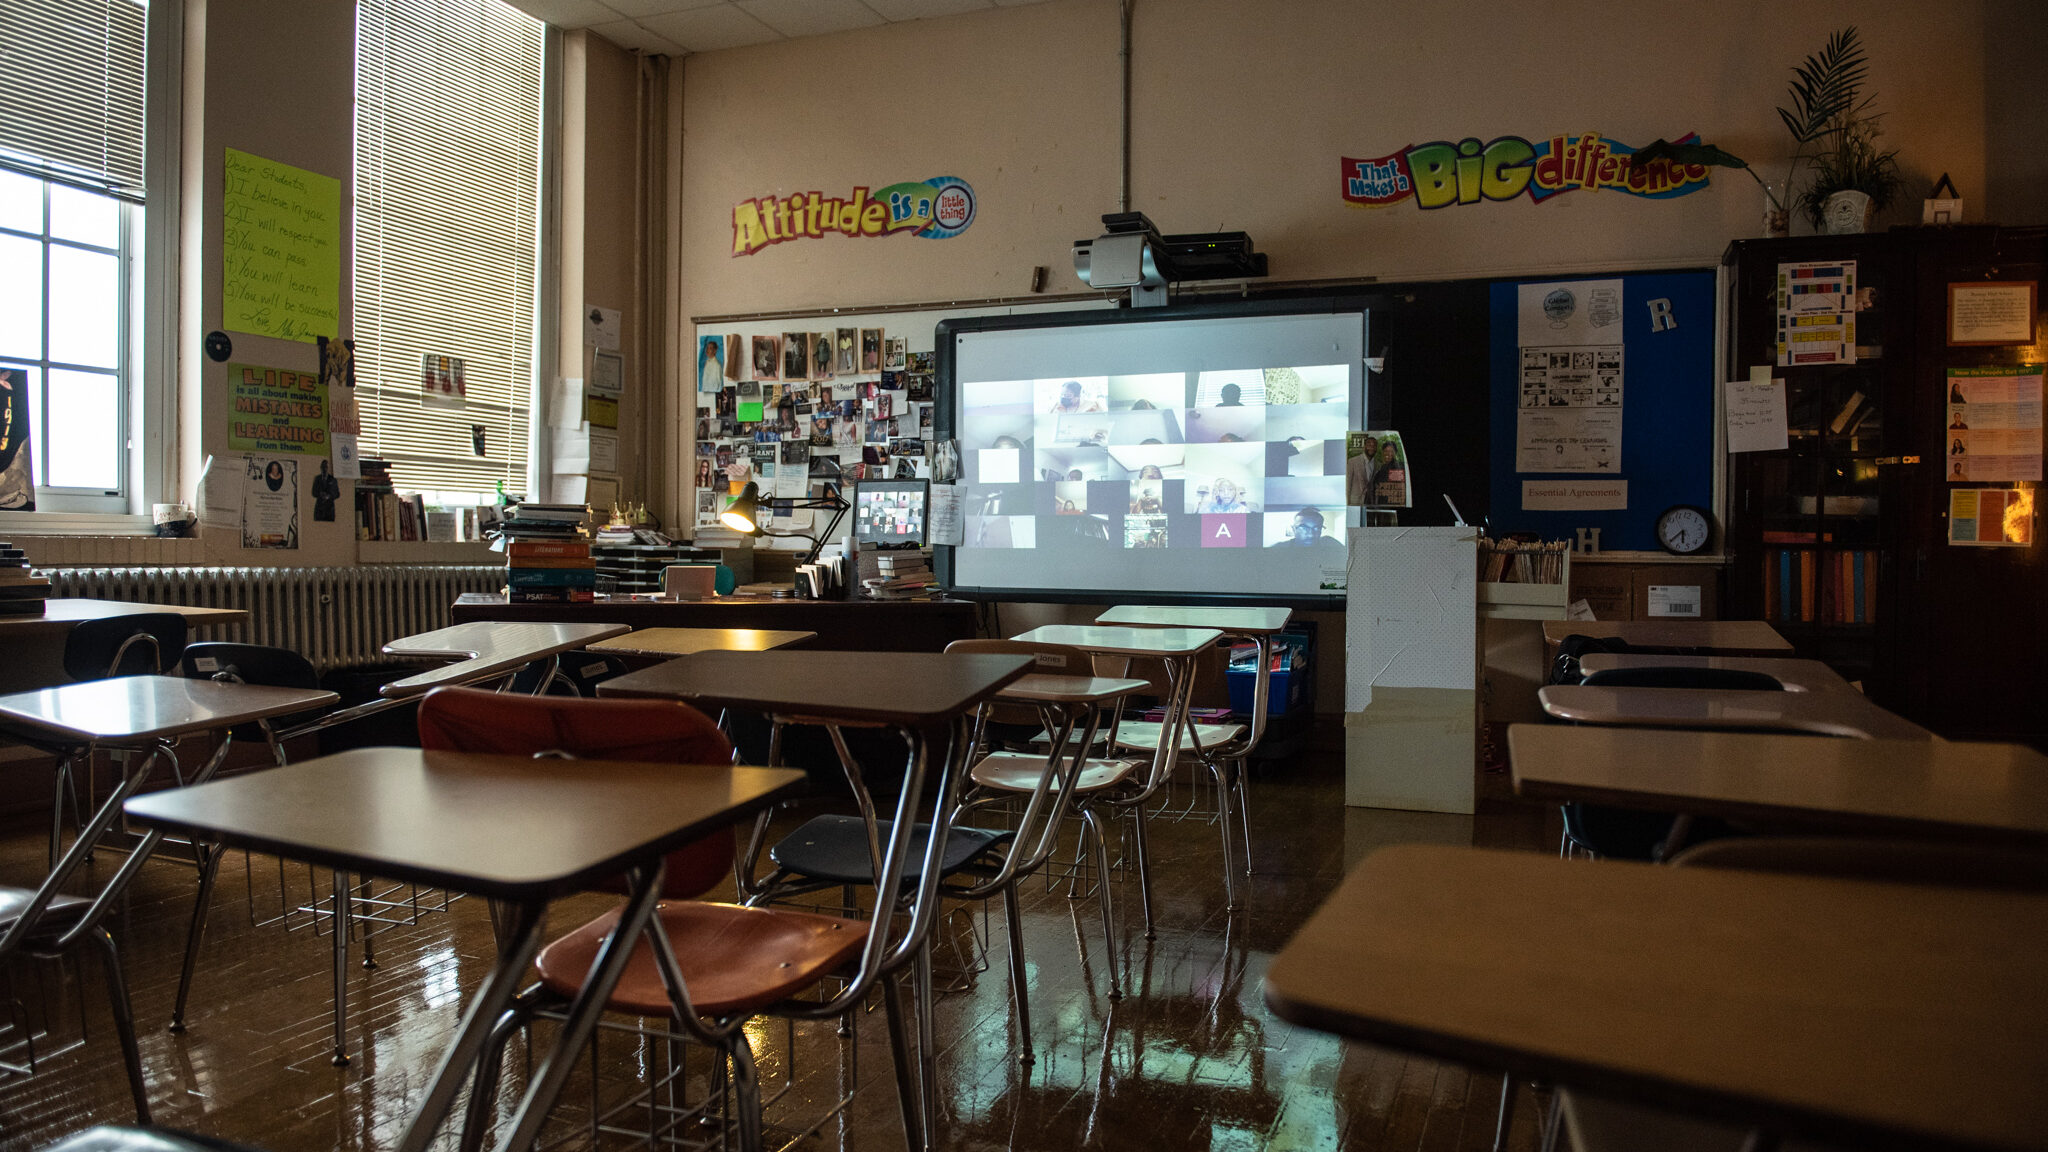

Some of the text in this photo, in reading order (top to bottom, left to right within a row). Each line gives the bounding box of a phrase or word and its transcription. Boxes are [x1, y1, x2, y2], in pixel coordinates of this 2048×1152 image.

[225, 153, 255, 174] Dear
[1357, 159, 1400, 181] That
[1534, 131, 1710, 195] difference
[1348, 175, 1409, 199] Makes a
[252, 184, 289, 210] believe
[292, 200, 302, 216] in
[941, 194, 965, 209] little
[733, 186, 931, 256] Attitude is a
[940, 205, 966, 220] thing
[258, 218, 276, 233] will
[279, 227, 314, 246] respect
[262, 245, 281, 260] can
[239, 255, 258, 279] You
[262, 271, 283, 284] will
[288, 273, 319, 297] learn
[239, 283, 256, 301] You
[260, 294, 281, 308] will
[284, 297, 296, 311] be
[1646, 297, 1678, 333] R
[242, 368, 317, 392] LIFE
[236, 385, 322, 404] is all about making
[235, 396, 322, 419] MISTAKES
[272, 416, 289, 425] and
[234, 421, 325, 444] LEARNING
[256, 440, 305, 452] from them.
[1528, 488, 1622, 499] Essential Agreements
[1684, 511, 1692, 520] 12
[1215, 522, 1232, 538] A
[1576, 527, 1601, 554] H
